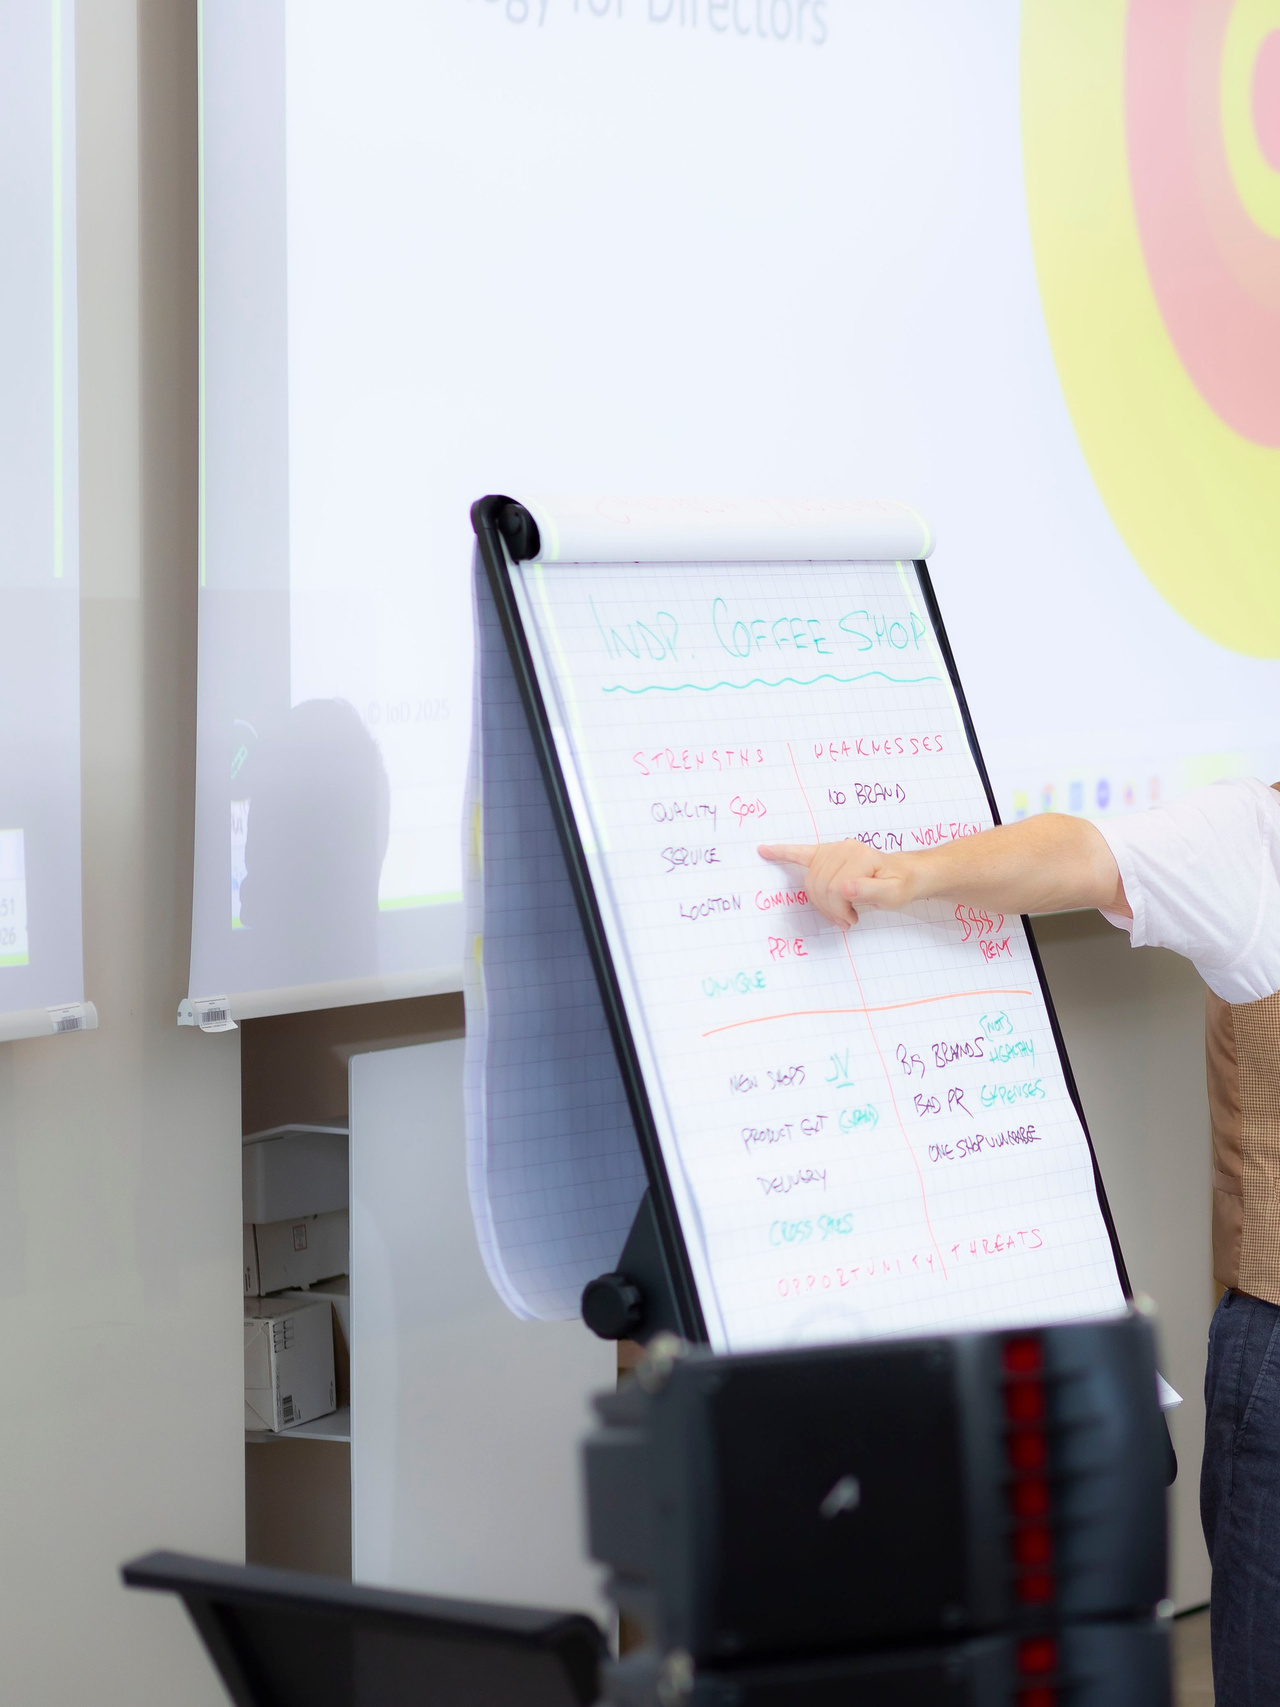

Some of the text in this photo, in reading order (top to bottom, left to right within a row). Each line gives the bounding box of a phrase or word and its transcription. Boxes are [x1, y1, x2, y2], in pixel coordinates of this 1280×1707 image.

[712, 597, 834, 658] COFFEE
[838, 610, 926, 651] SHOP
[632, 747, 764, 776] STRENGTHS
[814, 734, 944, 762] WEAKNESSES
[828, 782, 906, 805] NO BRAND
[651, 796, 767, 832] QUALITY GOOD
[844, 831, 903, 851] PACITY
[979, 936, 1013, 963] RENT
[702, 970, 766, 997] UNIQUE
[932, 1037, 984, 1068] BRANDS
[730, 1074, 758, 1095] NEW
[914, 1093, 942, 1117] BAD
[948, 1087, 975, 1119] PR
[741, 1123, 794, 1155] PRODUCT
[928, 1144, 955, 1162] ONE
[956, 1134, 984, 1158] SHOP
[757, 1168, 827, 1195] DELIVERY
[951, 1228, 1043, 1262] THREATS
[778, 1254, 935, 1297] OPPORTUNITY
